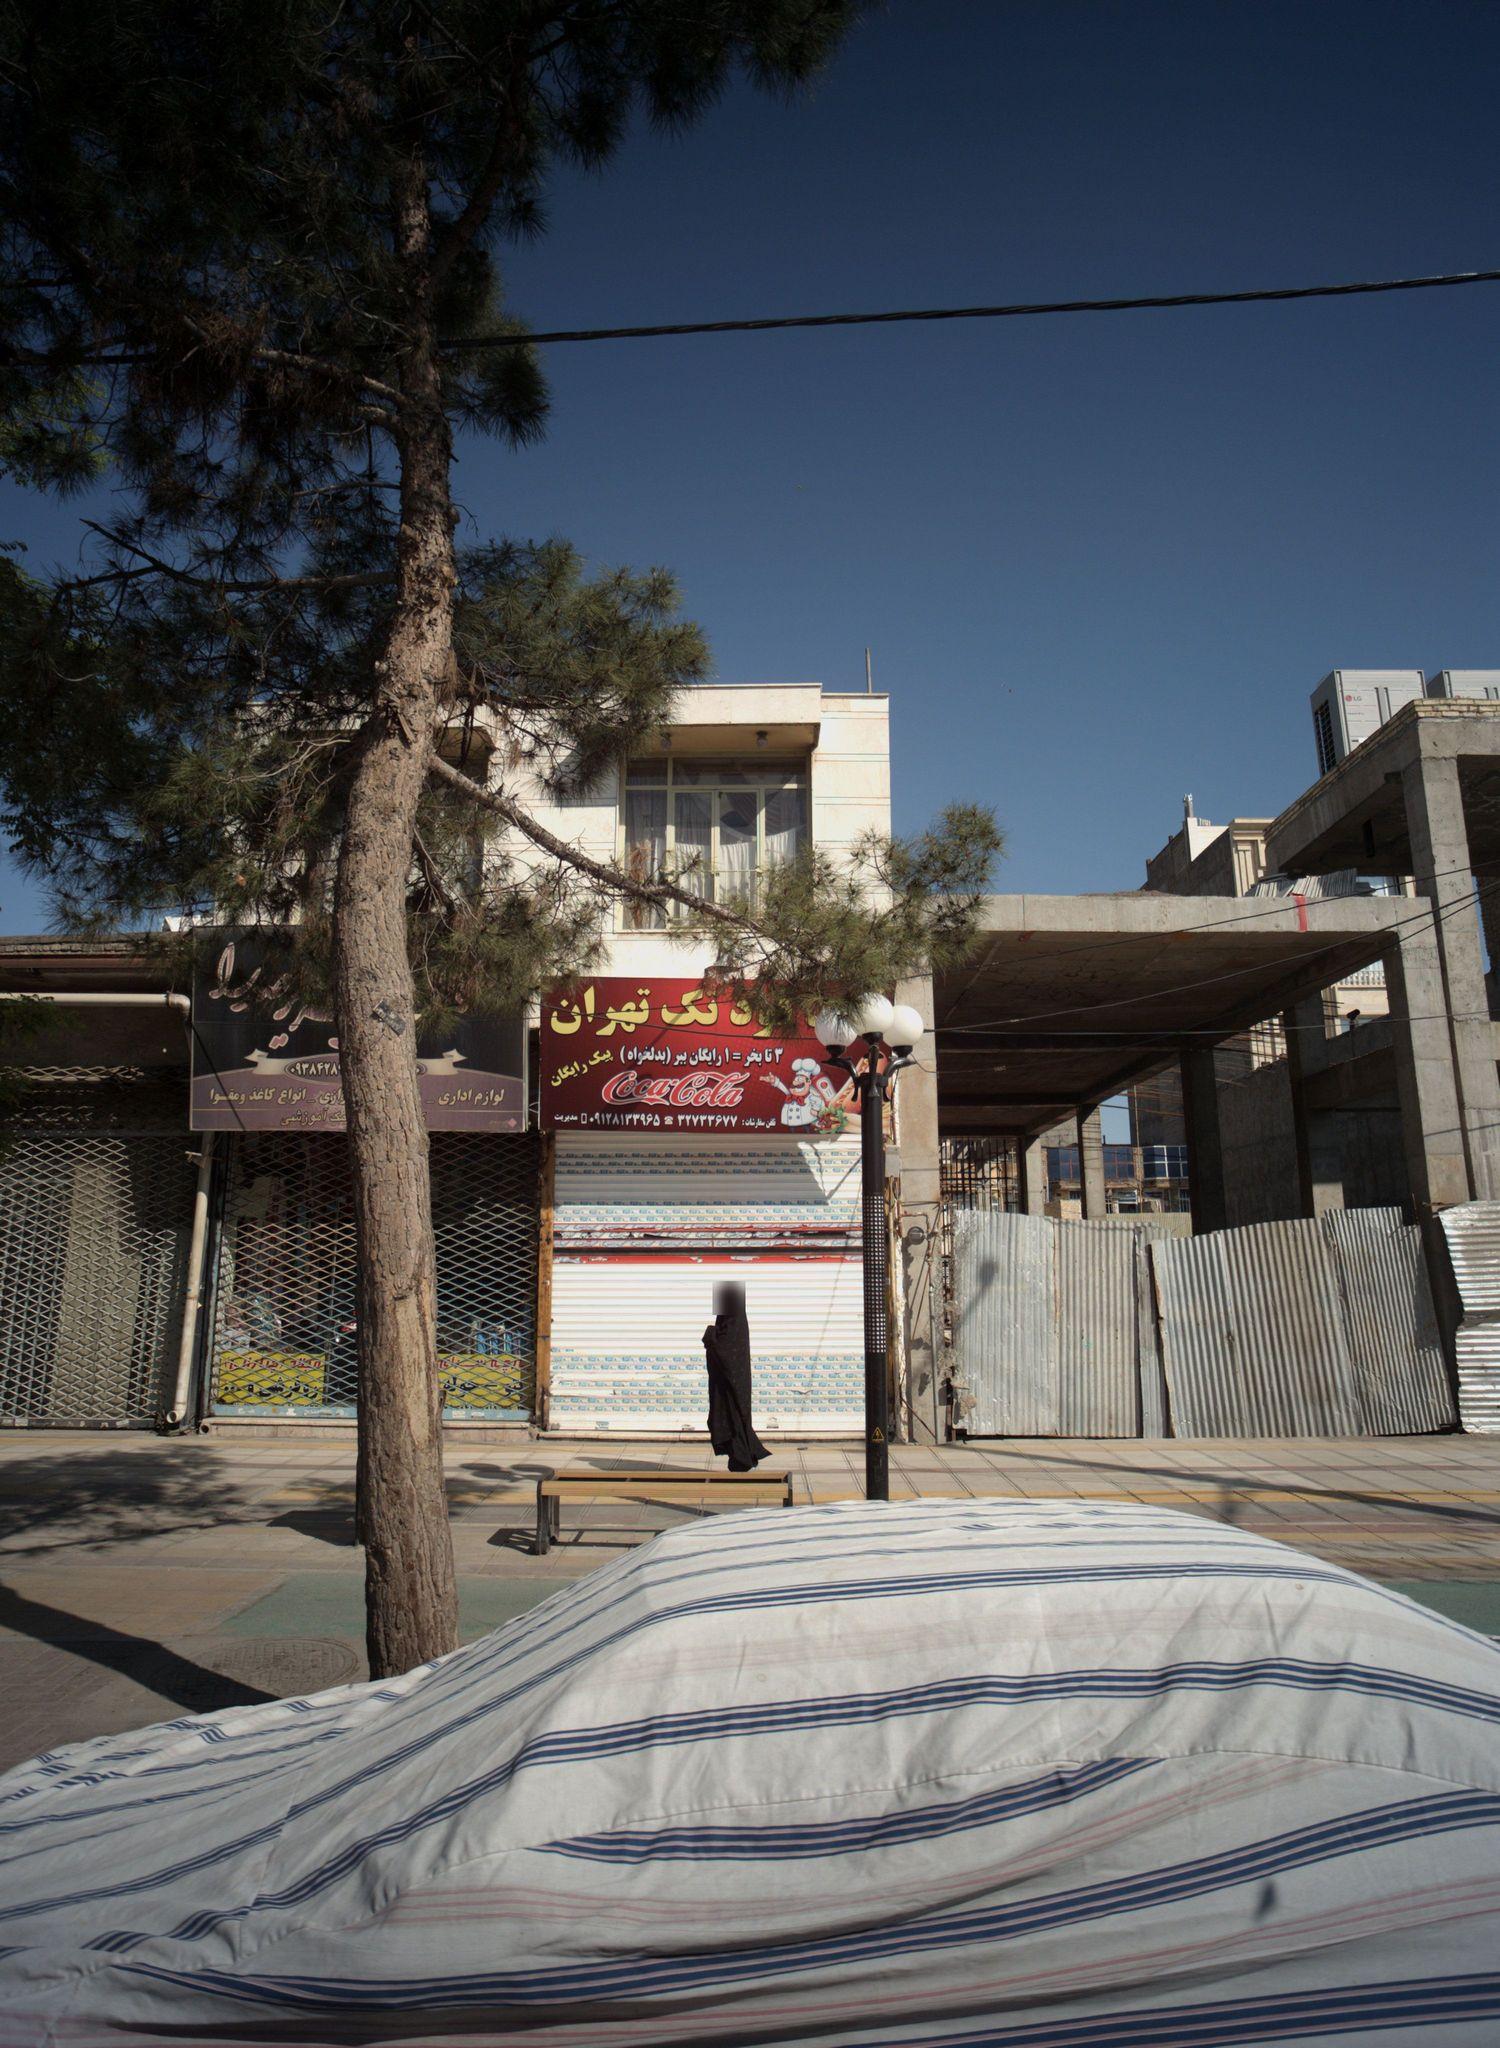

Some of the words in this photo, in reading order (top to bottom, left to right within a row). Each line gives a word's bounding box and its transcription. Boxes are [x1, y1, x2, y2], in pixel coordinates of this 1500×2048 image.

[550, 984, 651, 1037] تهران
[588, 1049, 615, 1066] پیک
[688, 1046, 722, 1067] رایگان
[744, 1047, 763, 1067] بخر
[764, 1048, 773, 1063] تا
[774, 1047, 784, 1064] ۳
[550, 1060, 589, 1087] رایگان
[249, 1087, 276, 1101] کاغذ
[277, 1087, 307, 1105] انواع
[438, 1087, 473, 1106] اداری
[474, 1087, 505, 1106] لوازم
[280, 1107, 328, 1126] آموزشی
[553, 1111, 579, 1122] مدیریت
[589, 1112, 660, 1126] ۰۹۱۲۸۱۳۳۹۶۵
[677, 1113, 738, 1127] ۳۲۷۳۳۶۷۷
